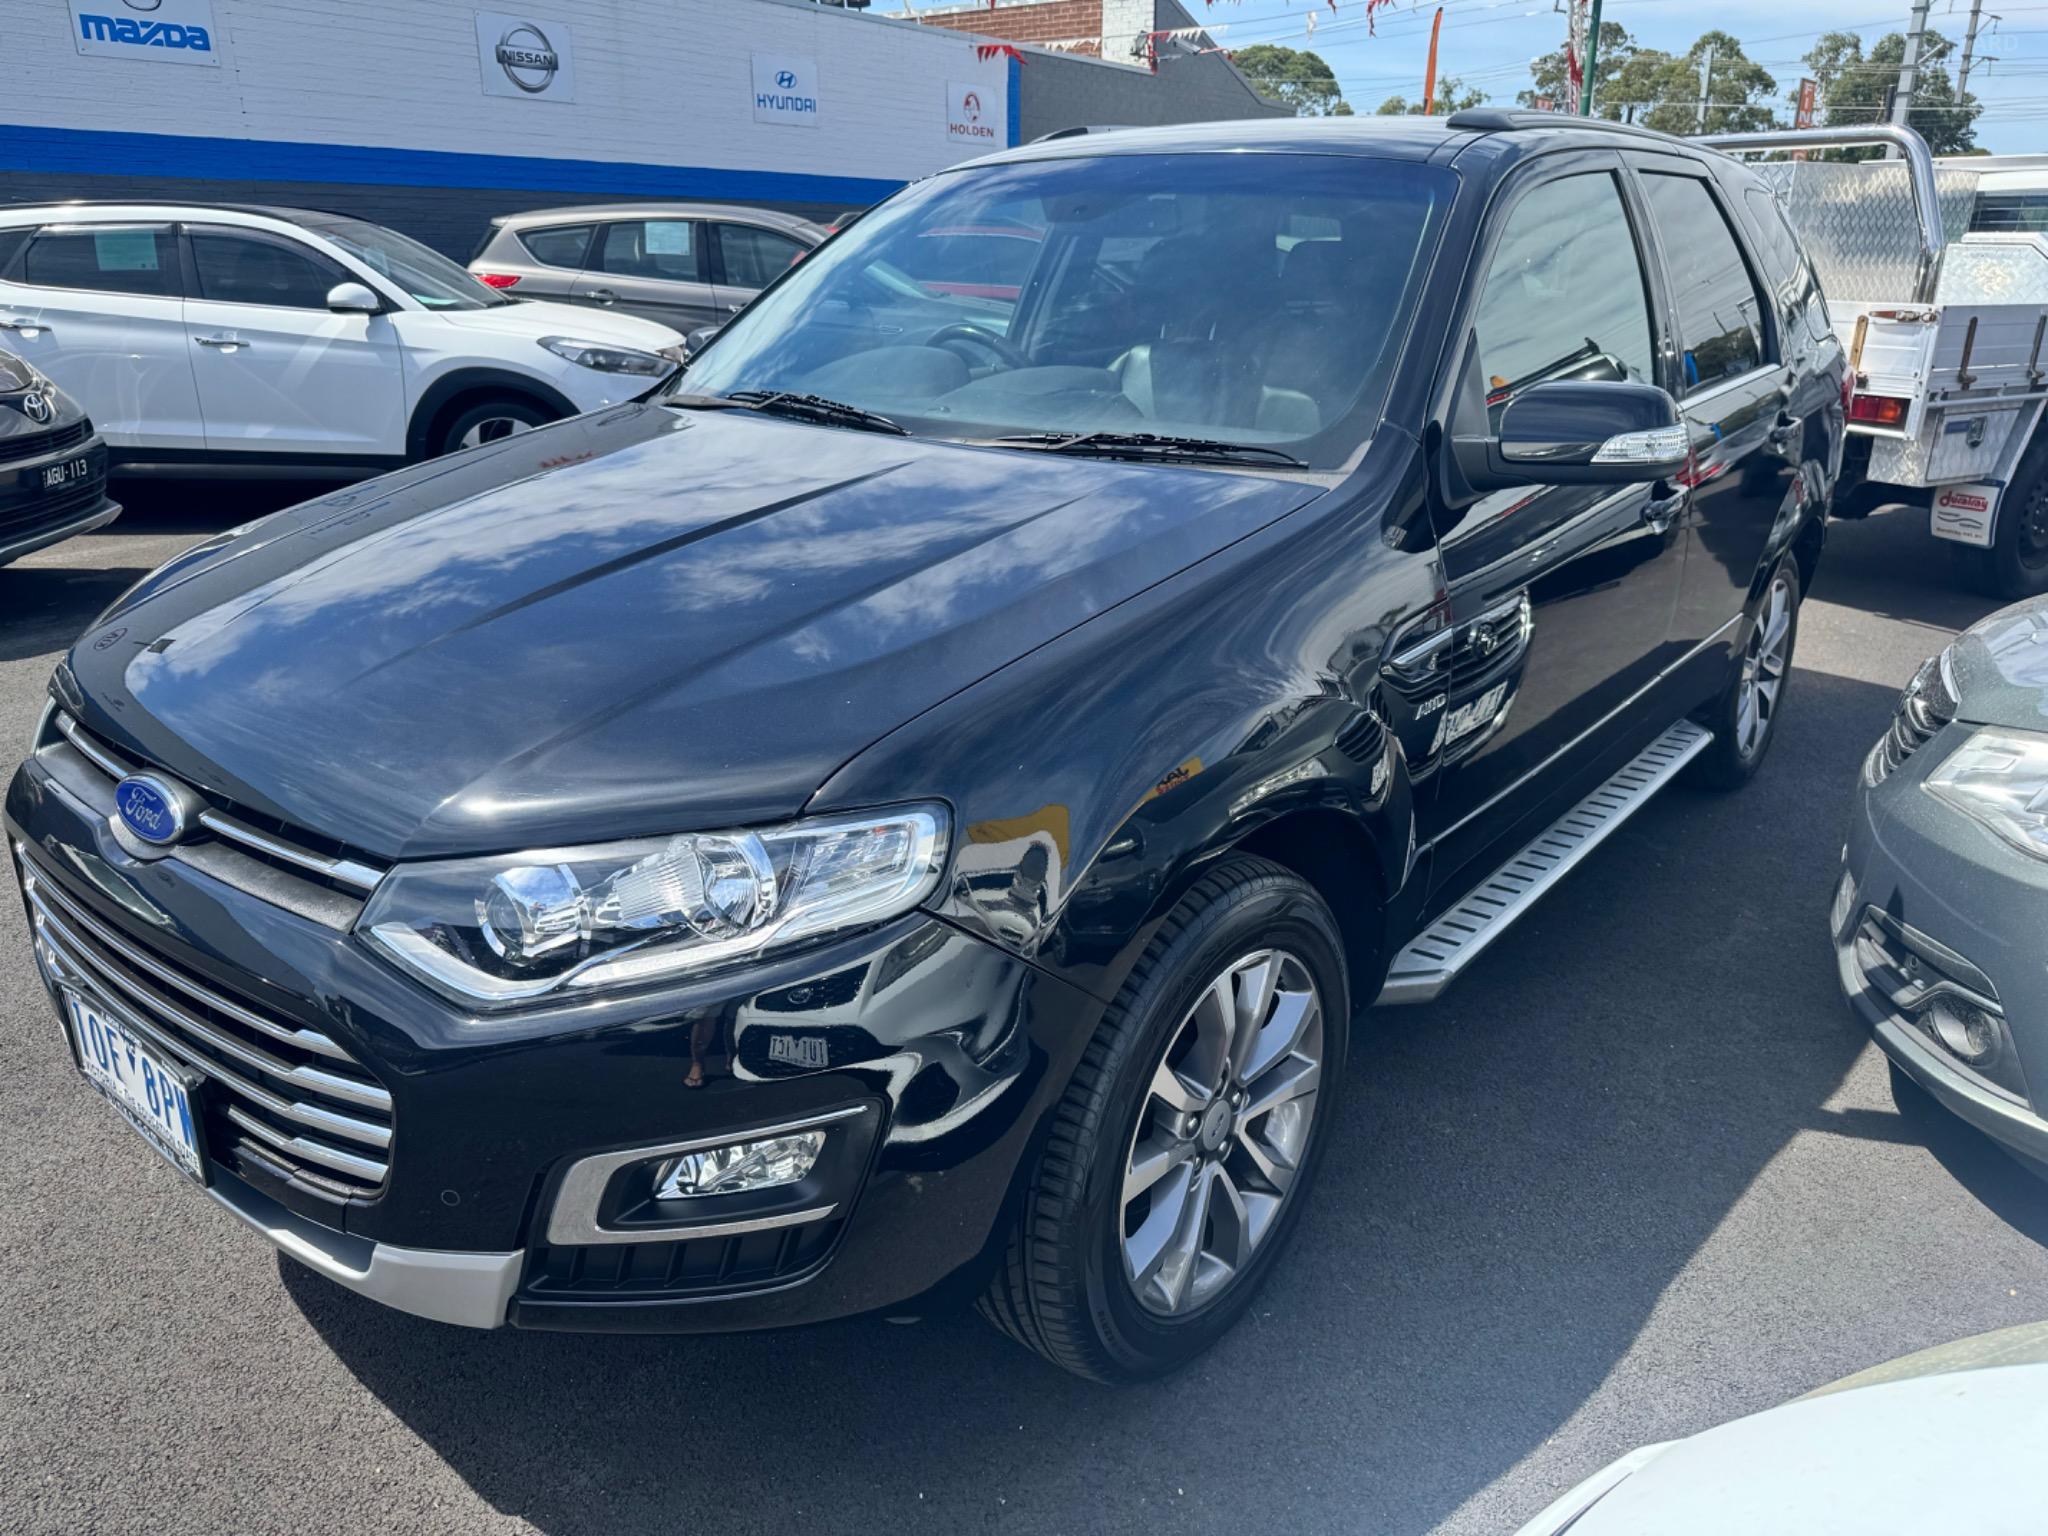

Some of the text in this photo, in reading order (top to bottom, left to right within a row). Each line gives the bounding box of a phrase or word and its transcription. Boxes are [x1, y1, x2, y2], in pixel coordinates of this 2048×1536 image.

[79, 14, 211, 51] mazda
[501, 50, 553, 65] NISSAN
[756, 93, 816, 113] HYUNDAI
[949, 123, 995, 138] HOLDEN
[126, 786, 164, 830] Ford
